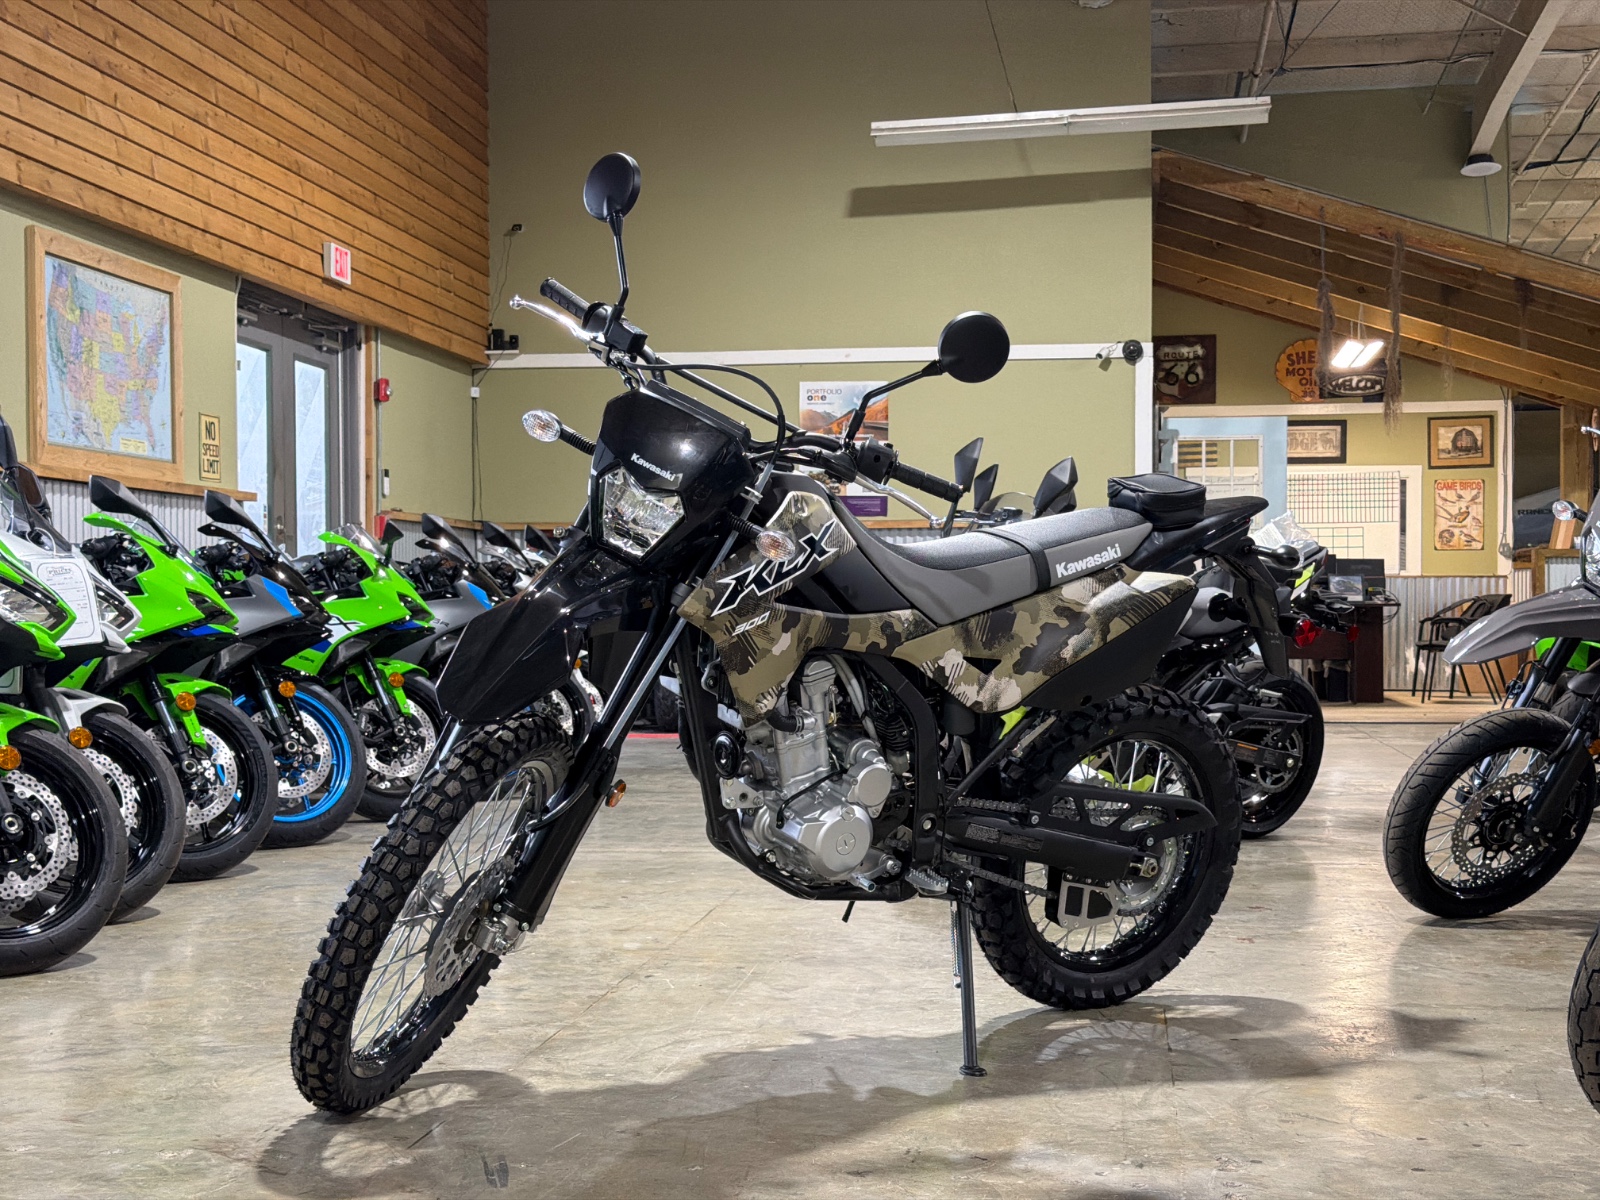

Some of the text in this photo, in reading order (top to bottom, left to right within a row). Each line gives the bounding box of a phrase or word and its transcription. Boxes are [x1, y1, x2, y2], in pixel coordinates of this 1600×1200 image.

[334, 246, 349, 281] EXIT
[1163, 350, 1200, 360] ROUTE
[1286, 350, 1316, 367] SHE
[1163, 362, 1200, 386] 66
[1285, 367, 1314, 377] MOT
[1330, 376, 1385, 393] WELCOM
[205, 420, 216, 441] NO
[203, 443, 220, 458] SPEED
[1288, 438, 1318, 451] DGE
[203, 458, 220, 475] LIMIT
[631, 453, 676, 482] Kawasaki
[1436, 481, 1482, 491] GAME BIRDS
[710, 518, 840, 617] KLX
[1055, 543, 1122, 578] Kawasaki
[732, 611, 771, 636] 300
